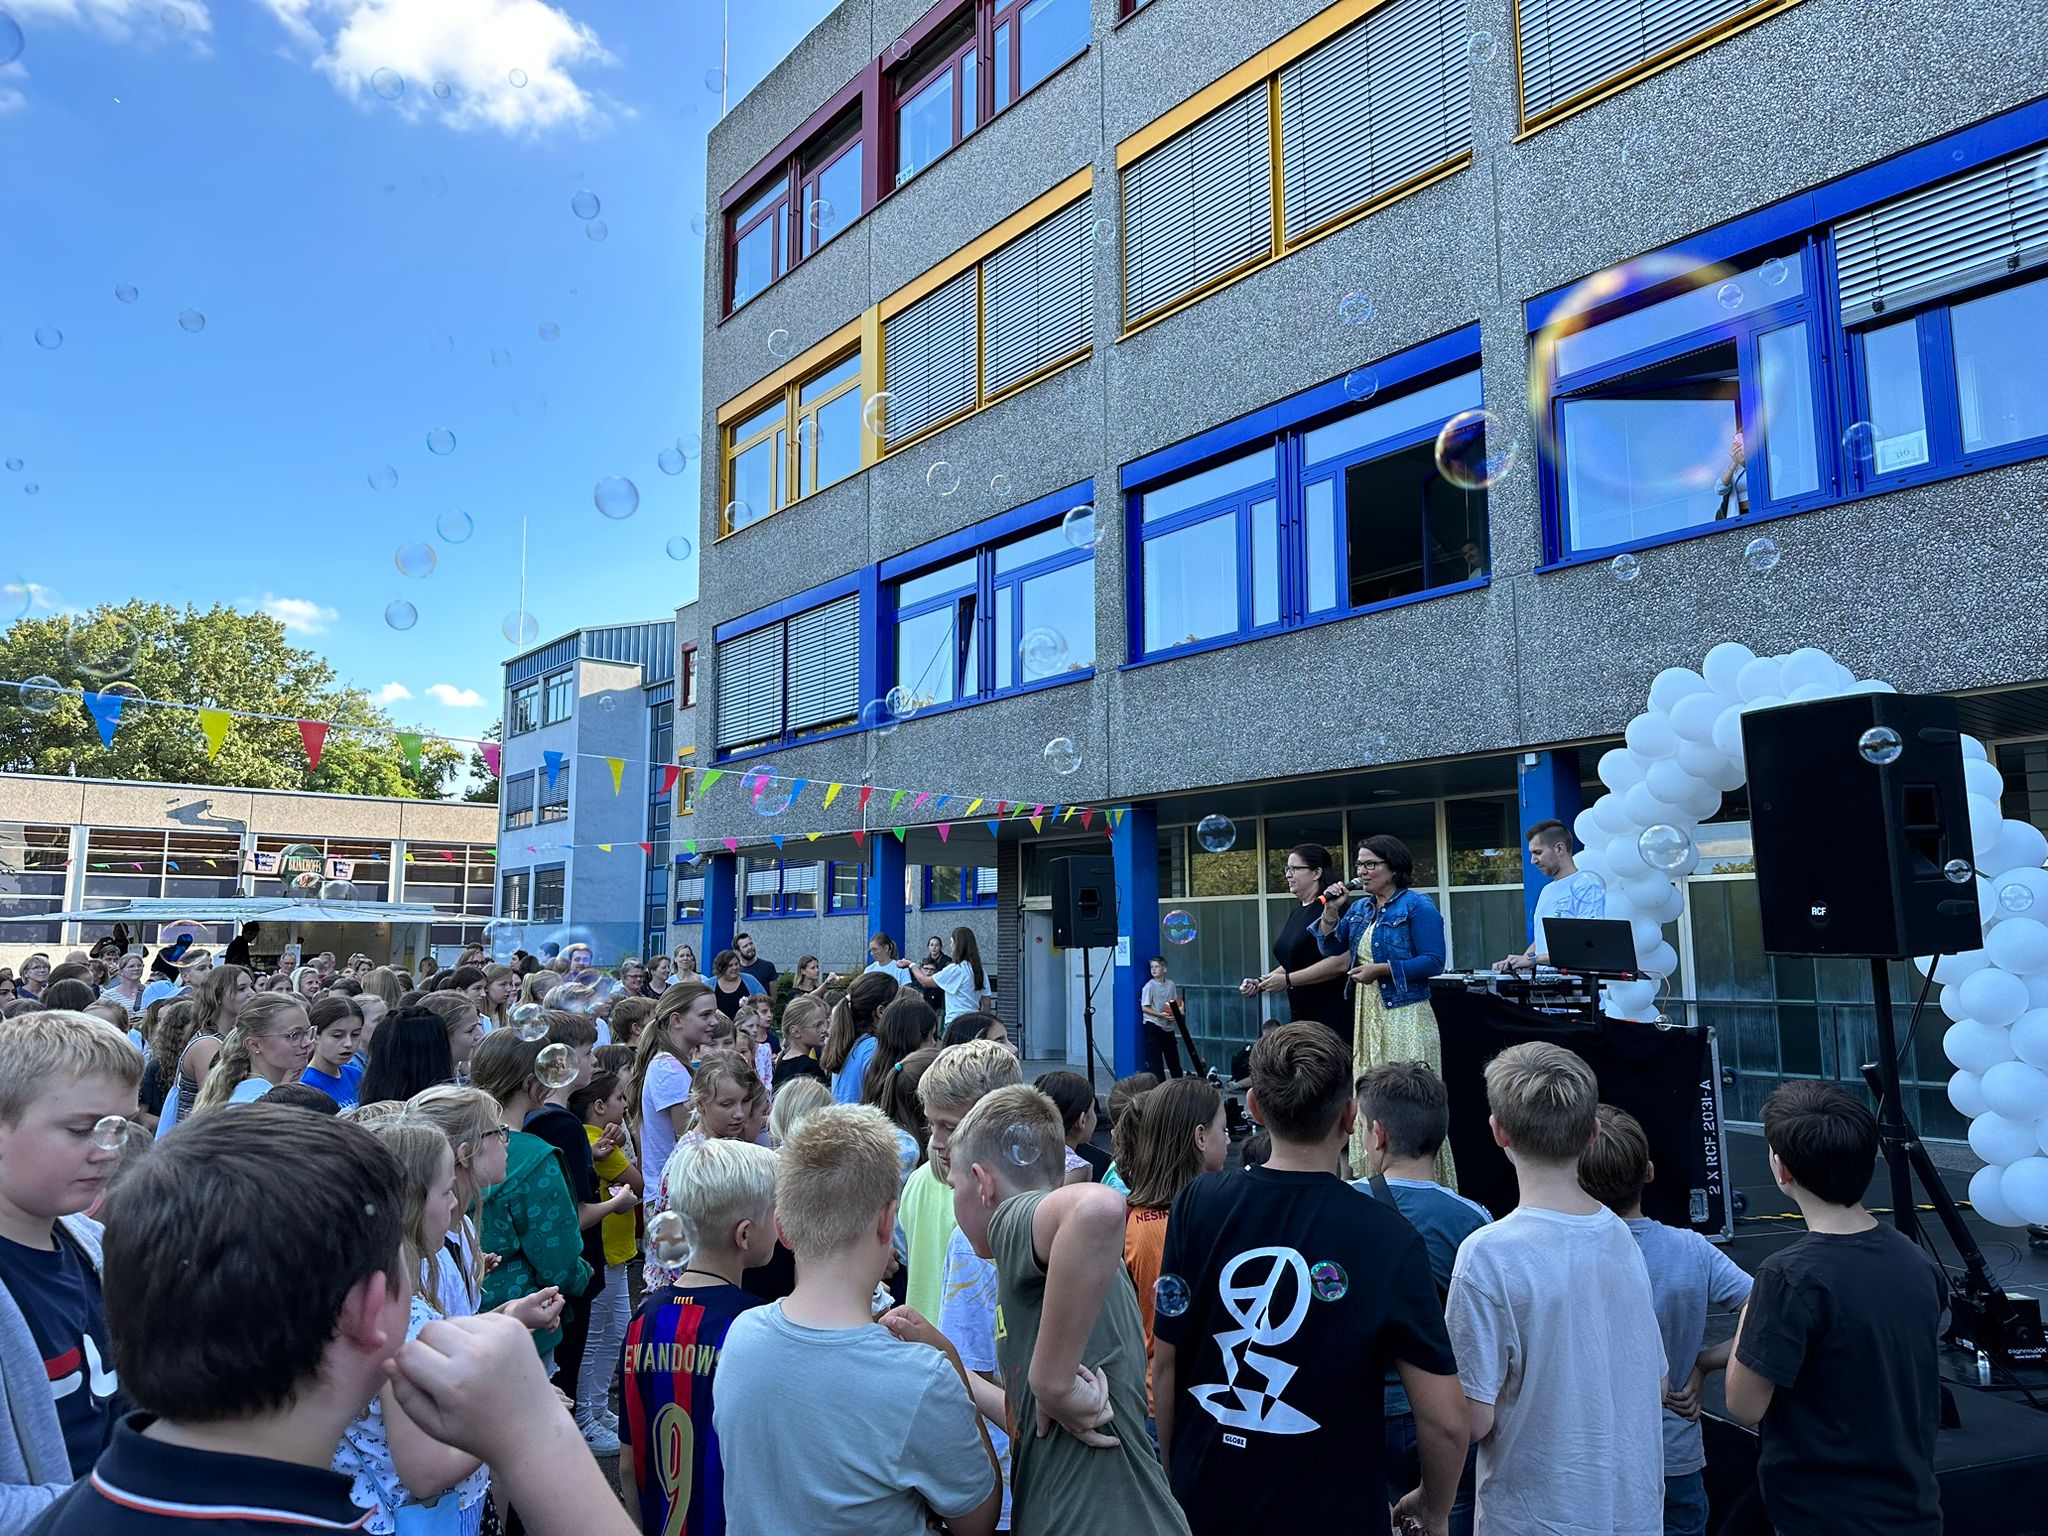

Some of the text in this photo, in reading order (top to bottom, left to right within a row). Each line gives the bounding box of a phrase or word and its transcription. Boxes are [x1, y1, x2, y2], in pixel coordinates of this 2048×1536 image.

[1811, 906, 1827, 916] RCF
[1706, 1170, 1720, 1181] X
[1708, 1185, 1721, 1195] 2
[1224, 1435, 1245, 1446] GLOBE
[652, 1402, 694, 1536] 9
